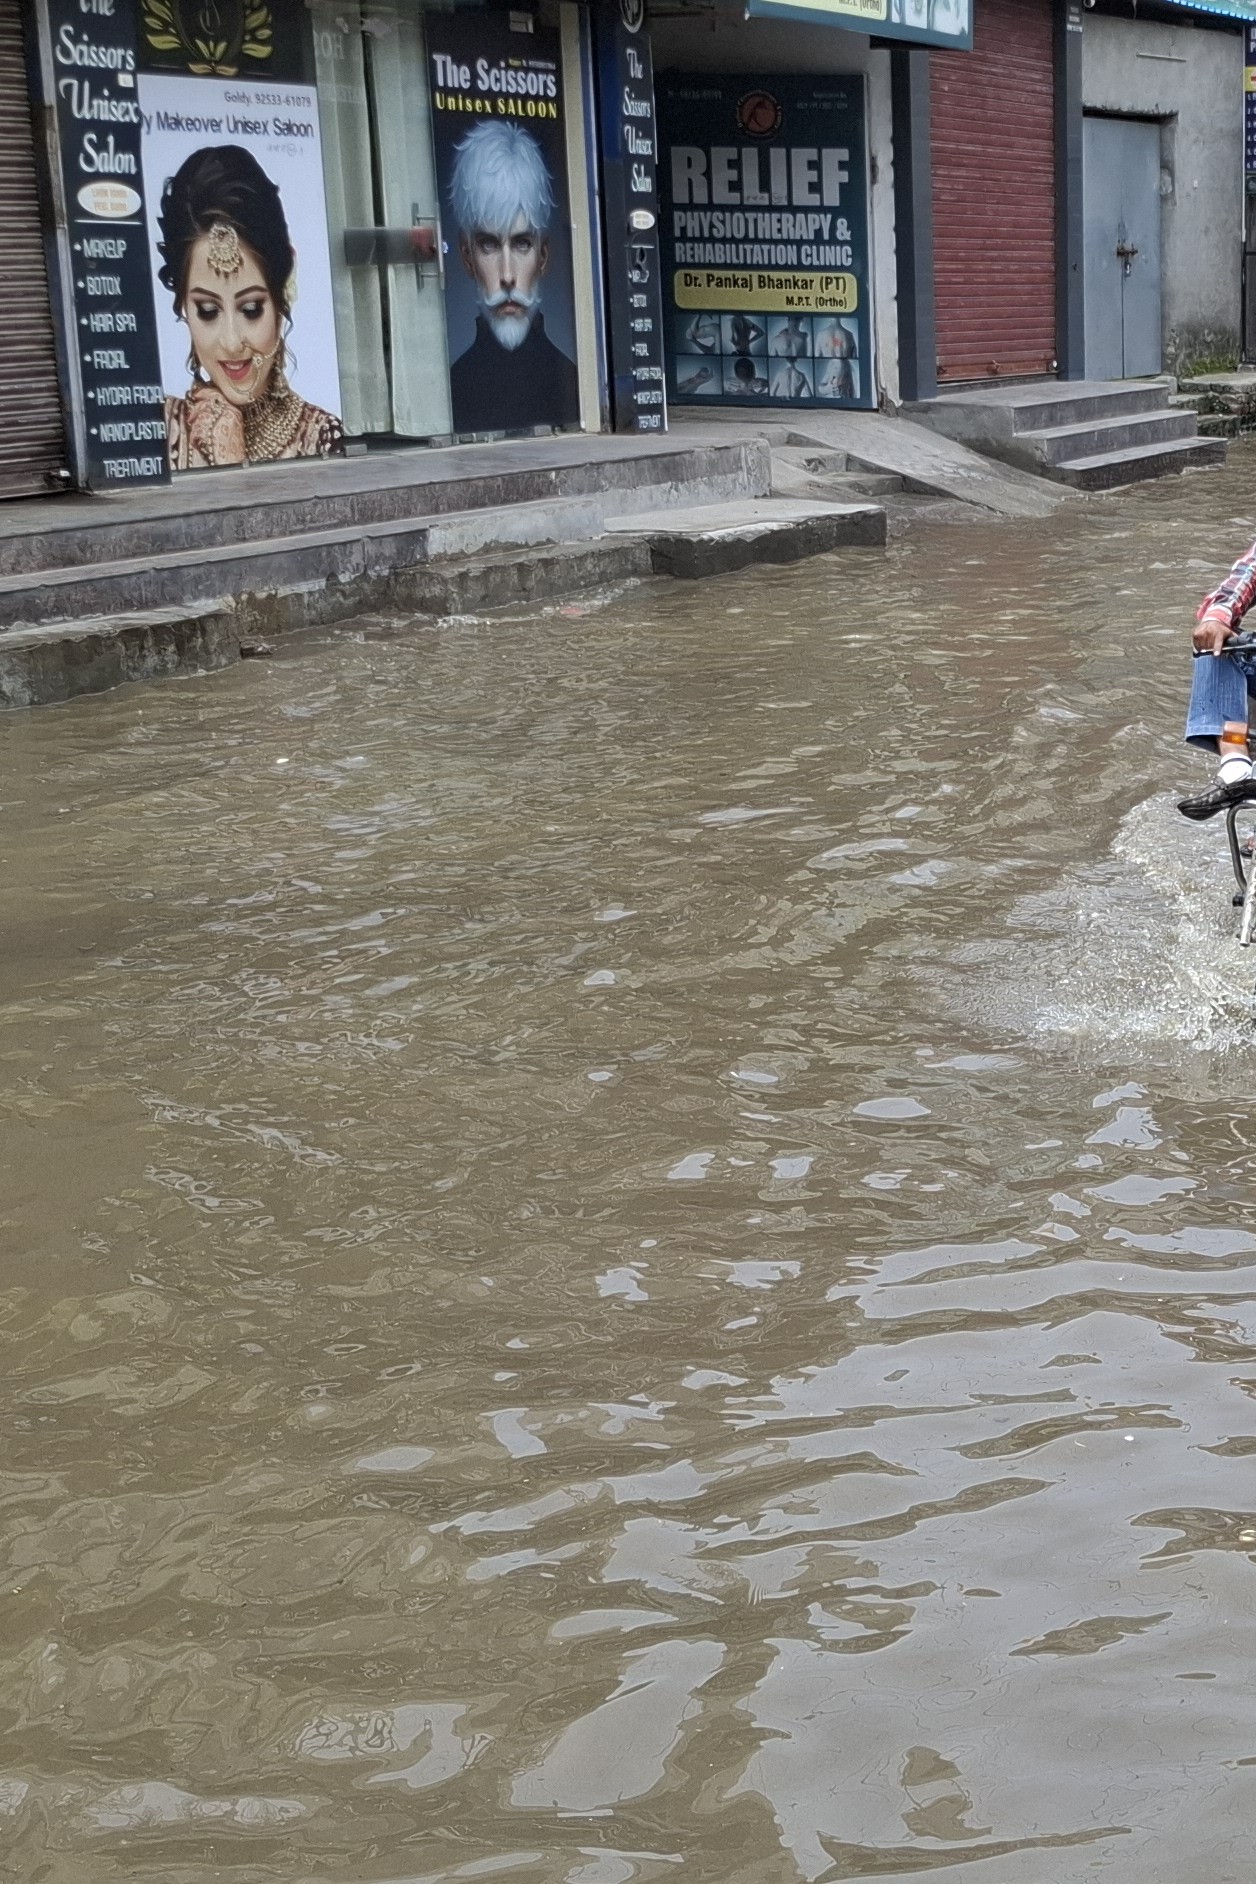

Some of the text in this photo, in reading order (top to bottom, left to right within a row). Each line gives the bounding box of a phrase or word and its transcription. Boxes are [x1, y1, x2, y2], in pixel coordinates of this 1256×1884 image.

[55, 24, 136, 71] Scissors
[432, 53, 556, 97] The Scissors
[626, 48, 643, 79] The
[58, 78, 141, 124] Unisex
[435, 91, 557, 118] Unisex SALOON
[156, 111, 223, 134] Makeover
[226, 115, 269, 136] Unisex
[273, 118, 314, 138] Saloon
[79, 132, 137, 175] Salon
[671, 146, 849, 206] RELIEF
[673, 211, 832, 240] PHYSIOTHERAPY
[836, 218, 851, 240] &
[83, 238, 127, 259] MAKEUP
[675, 243, 853, 266] REHABILITATION CLINIC
[86, 276, 122, 296] BOTOX
[684, 273, 847, 293] Dr. Pankaj Bhankar (PT)
[786, 296, 847, 308] M.P.T. (Ortho)
[90, 313, 137, 332] HAIR SPA
[103, 456, 163, 479] TREATMENT
